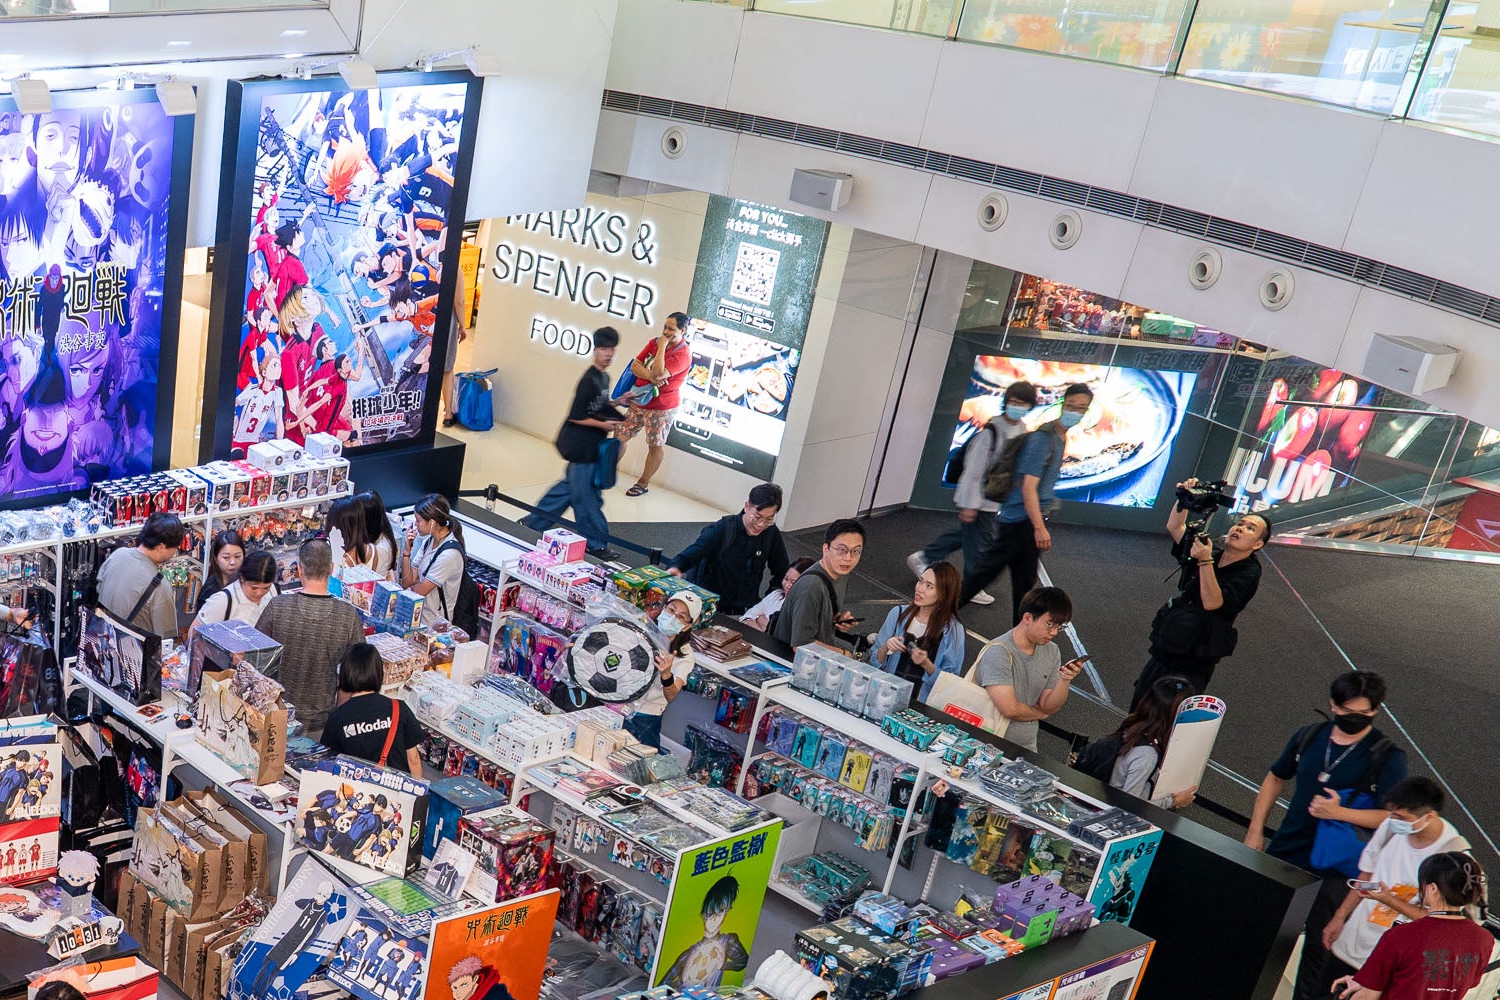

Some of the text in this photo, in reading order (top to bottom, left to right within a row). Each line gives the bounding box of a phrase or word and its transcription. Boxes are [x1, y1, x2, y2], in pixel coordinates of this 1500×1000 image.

[630, 220, 659, 264] &
[491, 243, 659, 326] SPENCER
[529, 316, 595, 357] FOOD
[245, 418, 259, 433] 3
[691, 832, 769, 878] 藍色監獄
[60, 926, 101, 953] 10 31
[299, 915, 312, 930] 11
